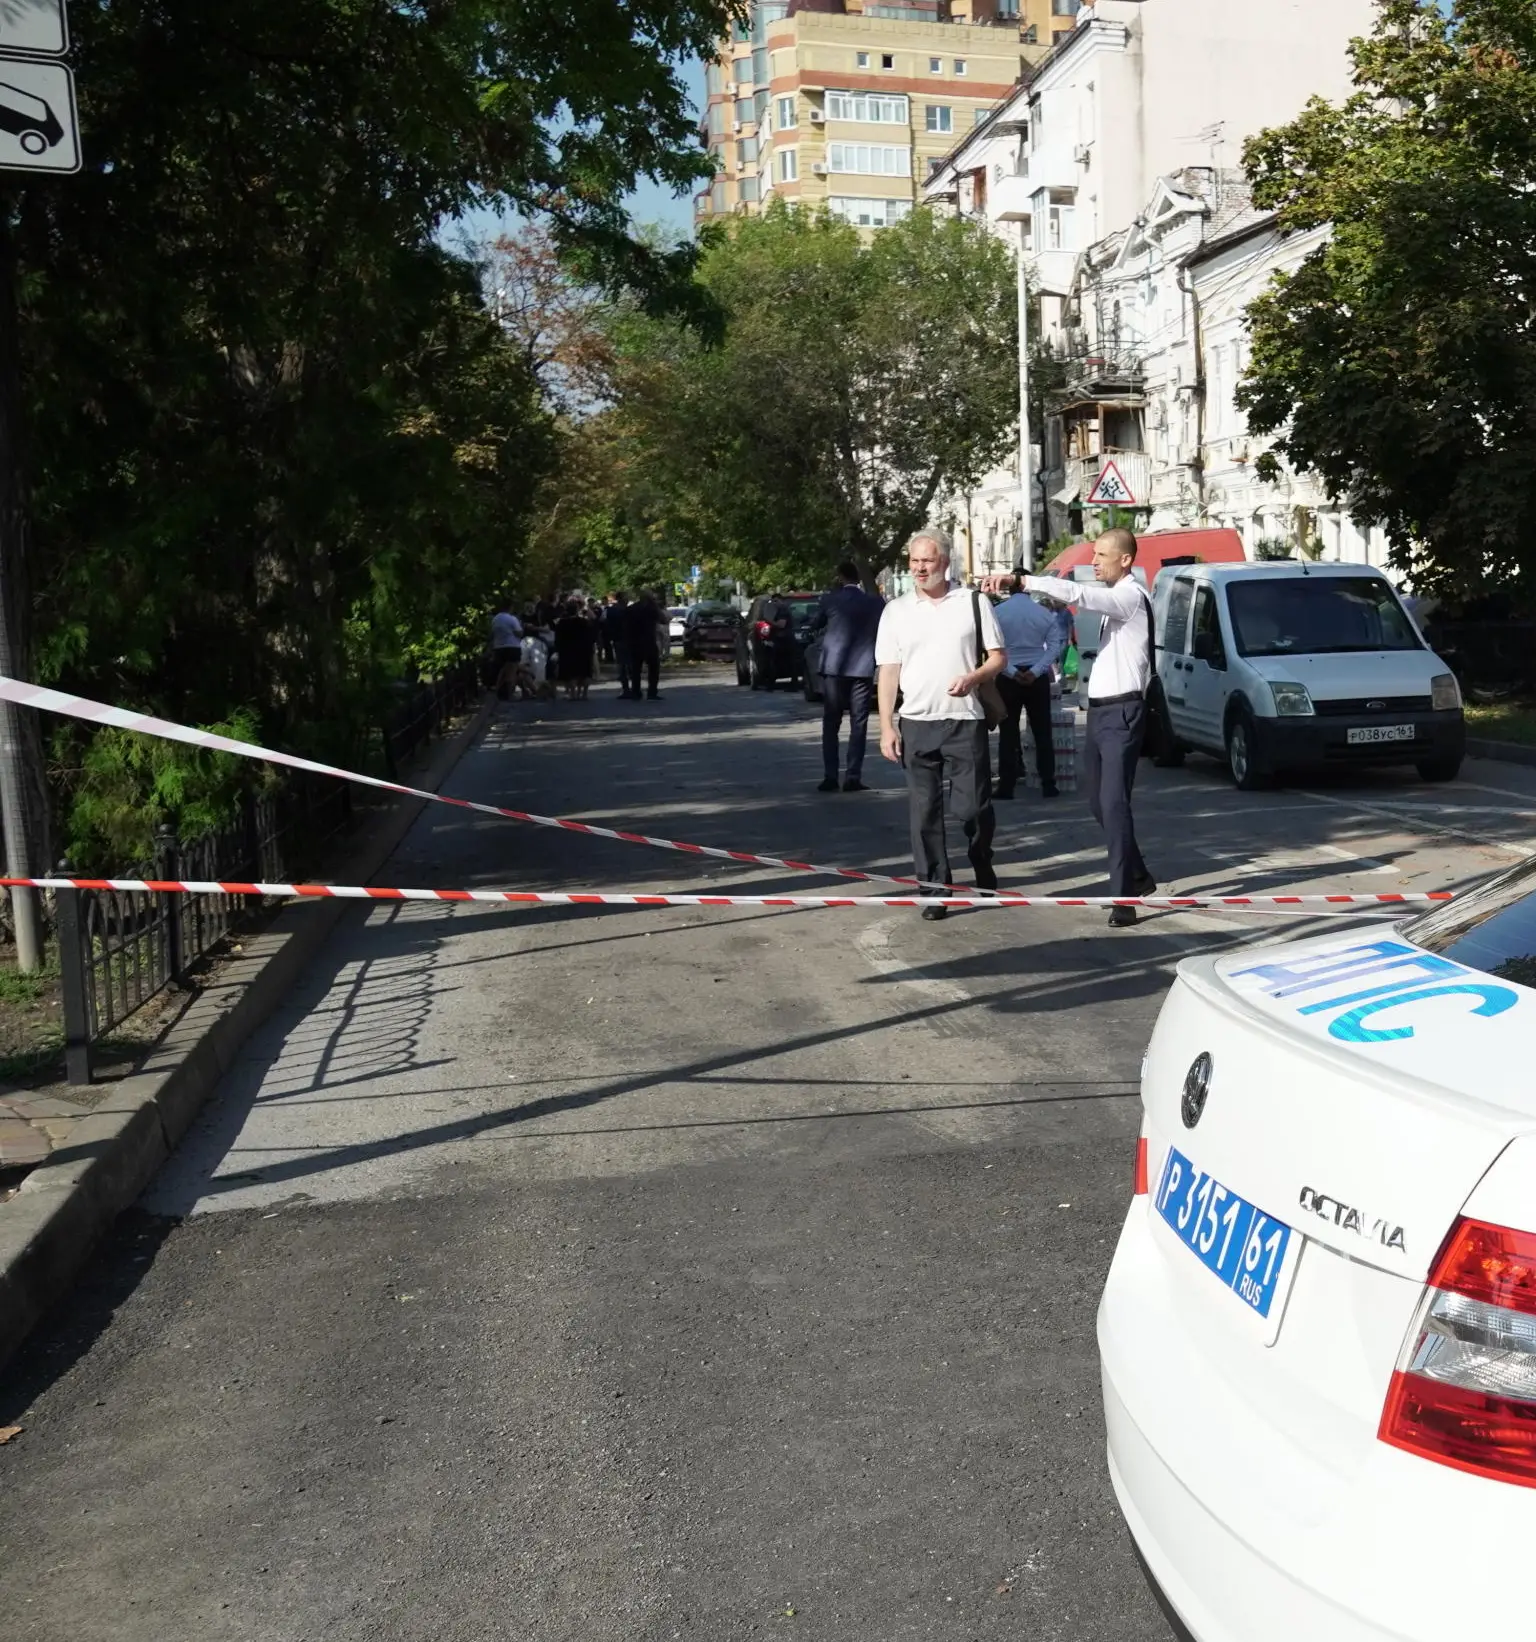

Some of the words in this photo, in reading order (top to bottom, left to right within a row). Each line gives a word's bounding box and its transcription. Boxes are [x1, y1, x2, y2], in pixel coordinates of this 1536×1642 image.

[1228, 941, 1519, 1043] ДПС
[1299, 1186, 1407, 1253] OCTAVIA
[1239, 1273, 1262, 1307] RUS
